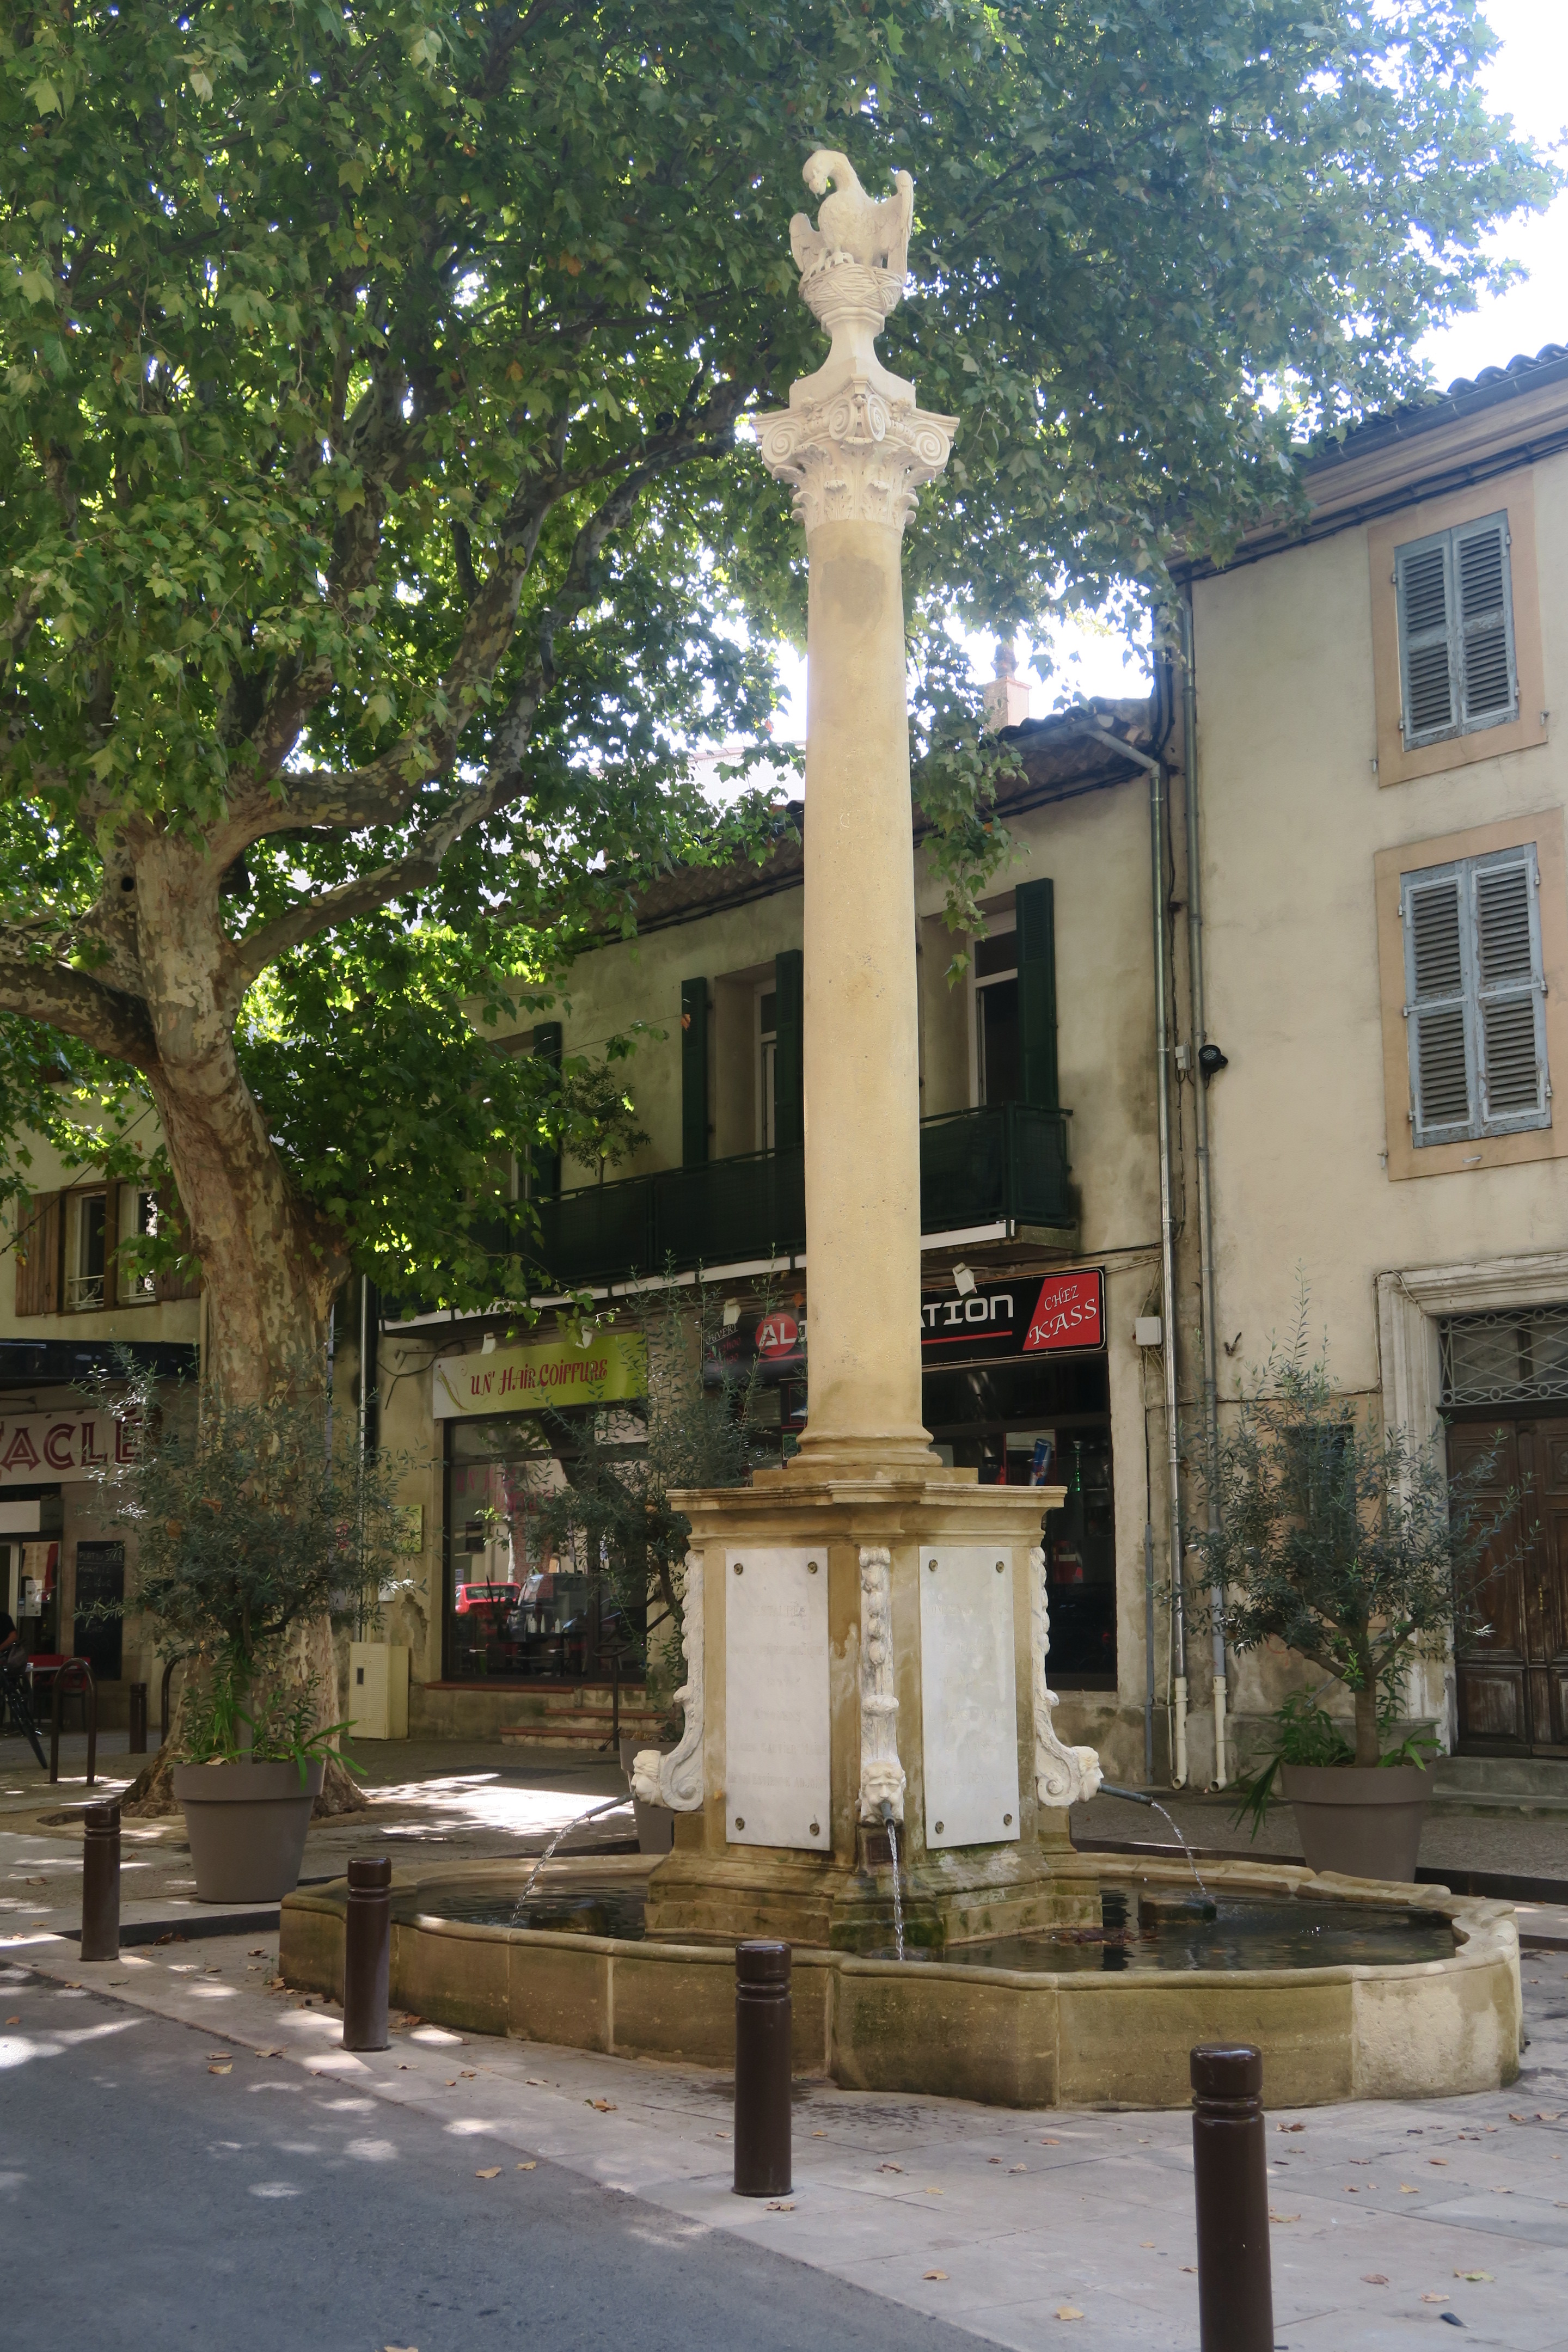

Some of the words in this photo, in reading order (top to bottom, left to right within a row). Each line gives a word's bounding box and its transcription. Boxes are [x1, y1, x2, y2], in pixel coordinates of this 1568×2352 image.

[1045, 1285, 1079, 1310] CHEZ
[1029, 1298, 1097, 1345] KASS
[0, 1407, 144, 1473] ACLÉ
